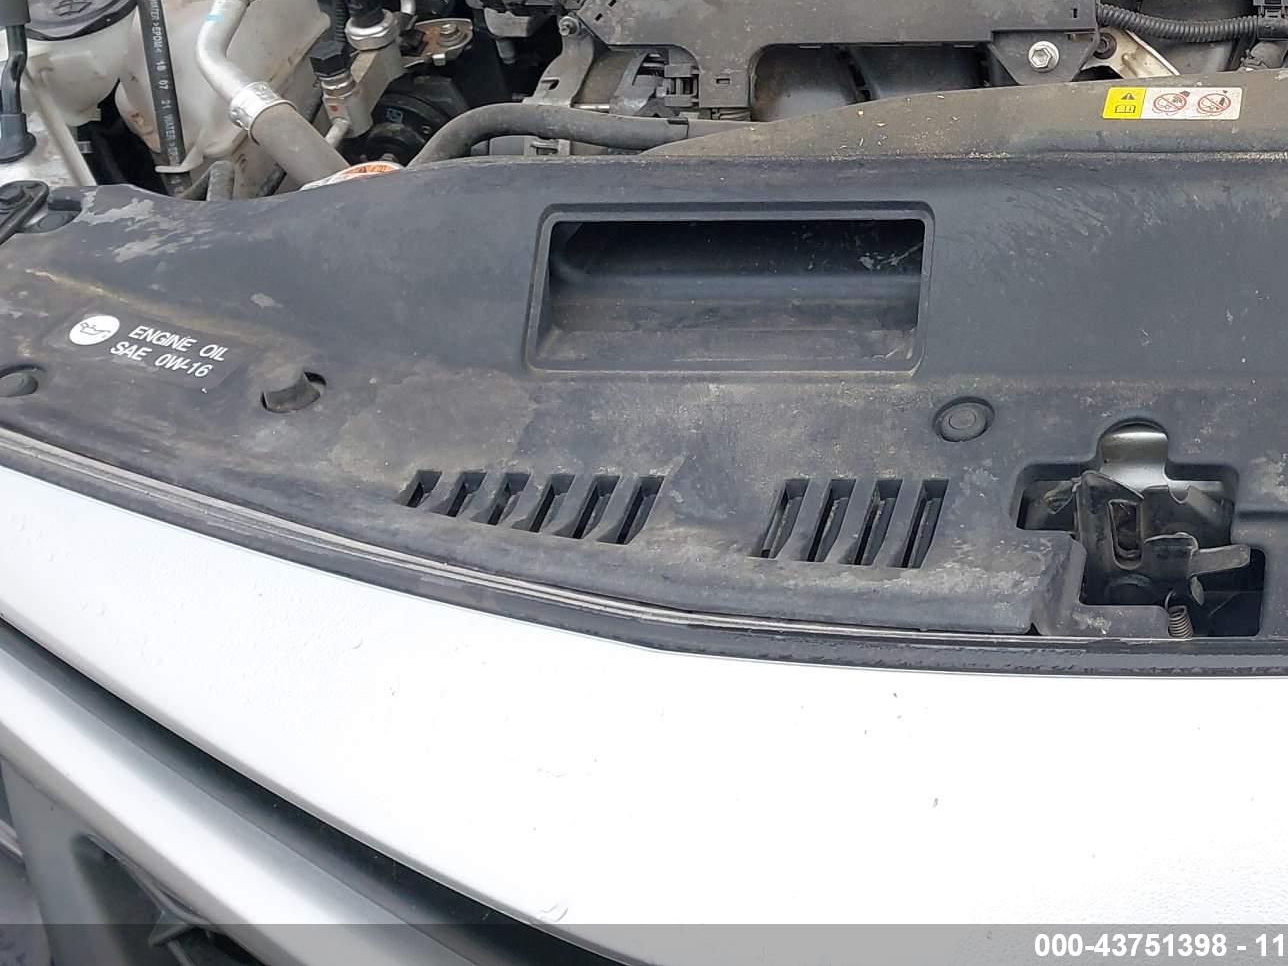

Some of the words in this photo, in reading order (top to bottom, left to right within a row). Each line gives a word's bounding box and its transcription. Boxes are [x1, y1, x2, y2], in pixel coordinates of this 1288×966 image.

[158, 79, 169, 90] 07
[163, 113, 176, 141] WATER
[128, 326, 197, 351] ENGINE
[199, 344, 228, 361] OIL
[110, 341, 153, 361] SAE
[154, 353, 214, 378] 0W-16
